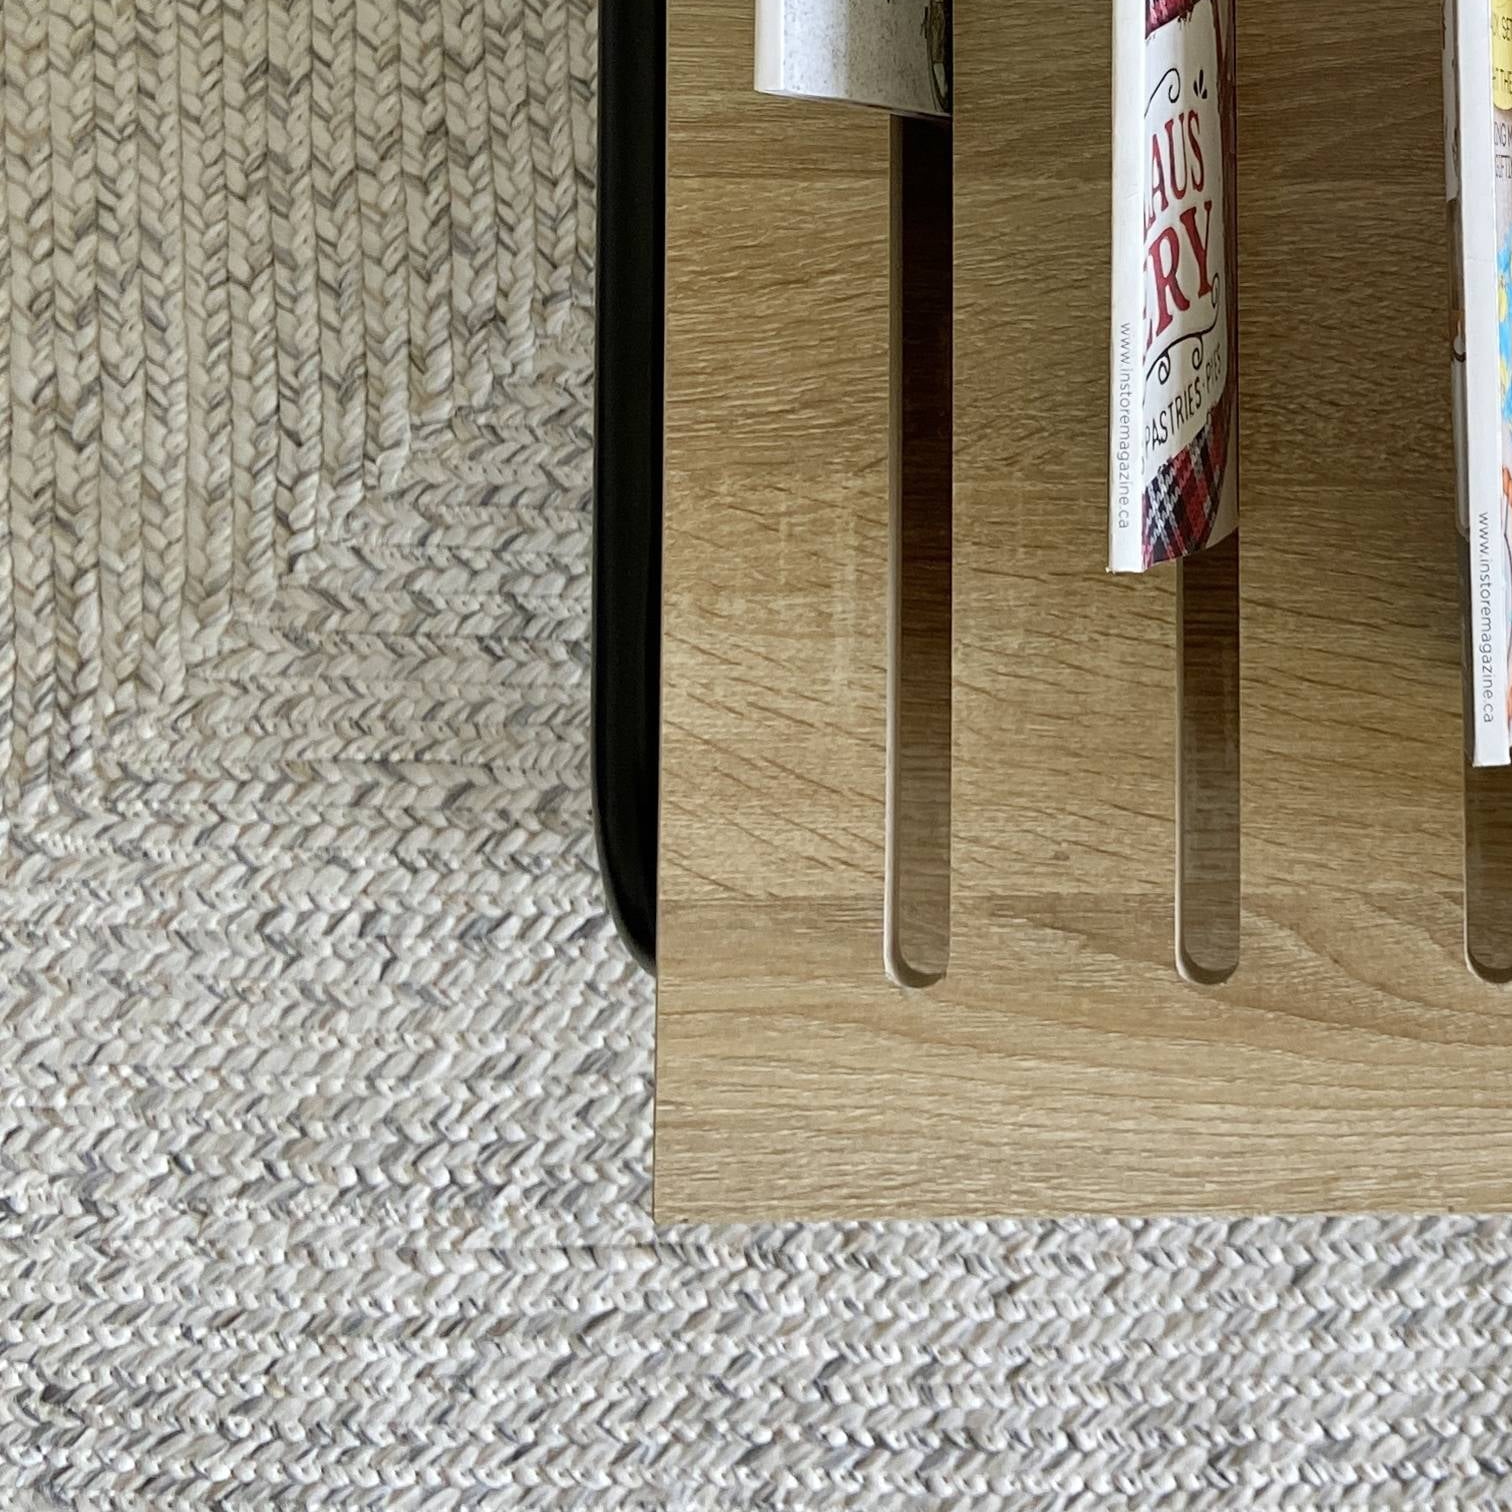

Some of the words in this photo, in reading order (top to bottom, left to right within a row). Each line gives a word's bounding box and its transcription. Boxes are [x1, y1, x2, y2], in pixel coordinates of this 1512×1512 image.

[1118, 321, 1134, 529] www.instoremagazine.ca
[1145, 376, 1202, 457] PASTRIES
[1479, 511, 1494, 724] www.instoremagazine.ca
